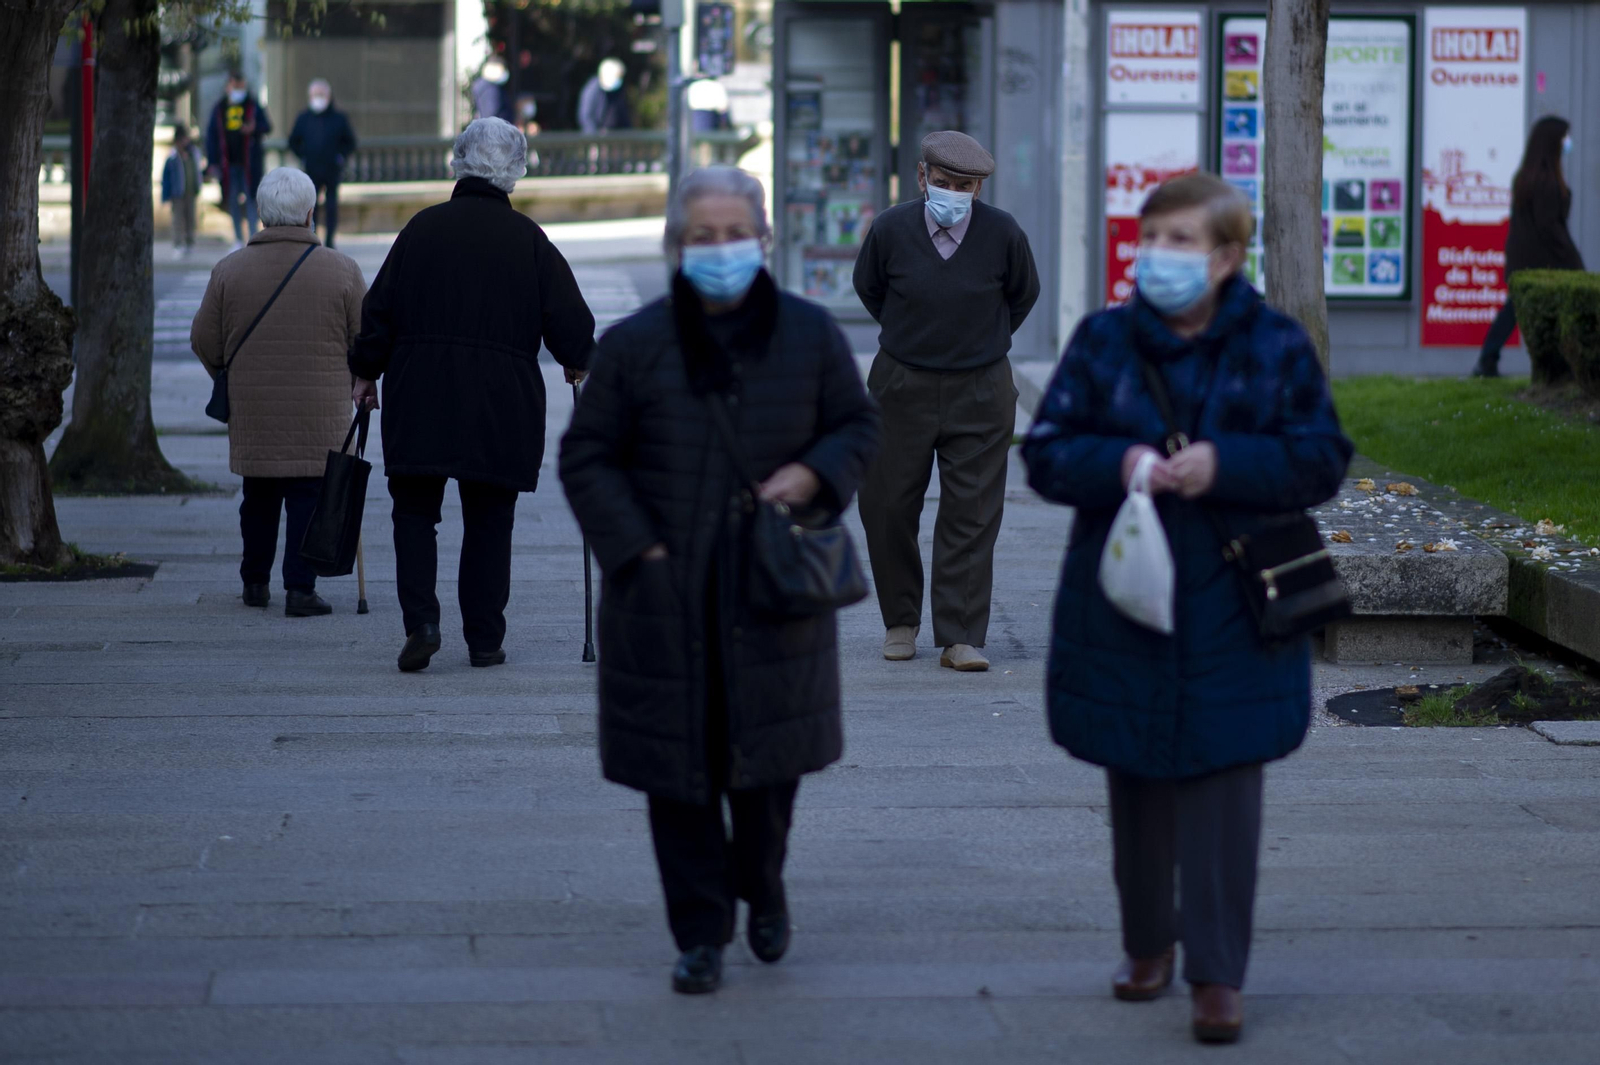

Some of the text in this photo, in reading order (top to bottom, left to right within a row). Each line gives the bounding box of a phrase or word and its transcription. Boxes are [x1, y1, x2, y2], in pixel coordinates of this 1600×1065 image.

[1113, 26, 1197, 56] ¡HOLA!
[1434, 29, 1518, 60] ¡HOLA!
[1110, 64, 1197, 82] Ourense
[1431, 68, 1518, 86] Ourense
[1445, 266, 1498, 285] de los
